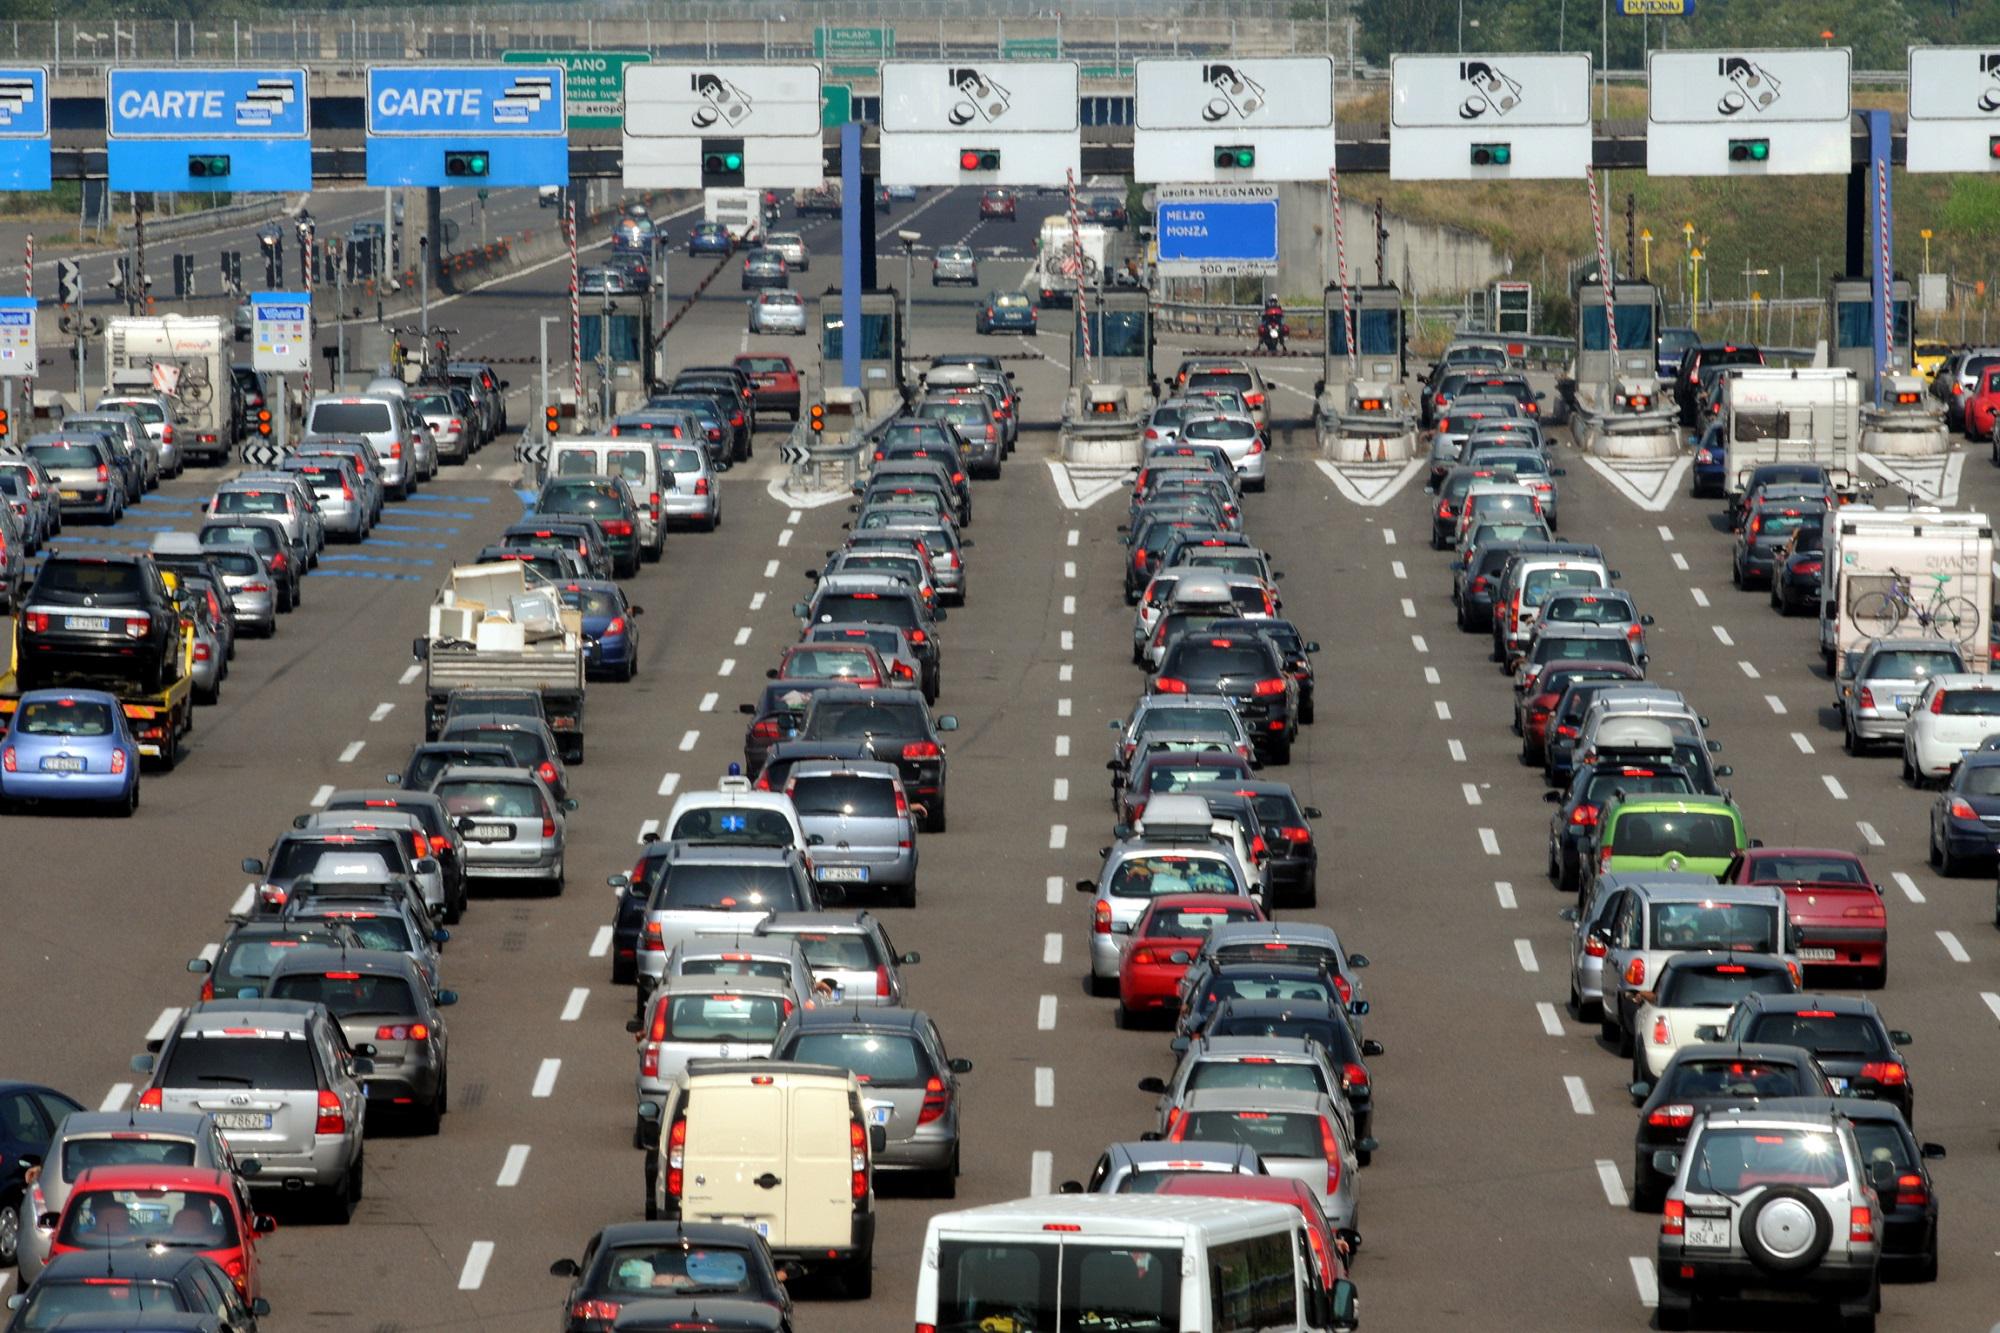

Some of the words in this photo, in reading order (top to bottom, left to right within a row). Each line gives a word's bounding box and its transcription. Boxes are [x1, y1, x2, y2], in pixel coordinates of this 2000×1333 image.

[118, 90, 224, 119] CARTE
[377, 88, 482, 116] CARTE
[1199, 187, 1273, 198] MELEGNANO
[1166, 211, 1205, 221] MELZO
[1166, 226, 1208, 237] MONZA
[1200, 265, 1222, 274] 500
